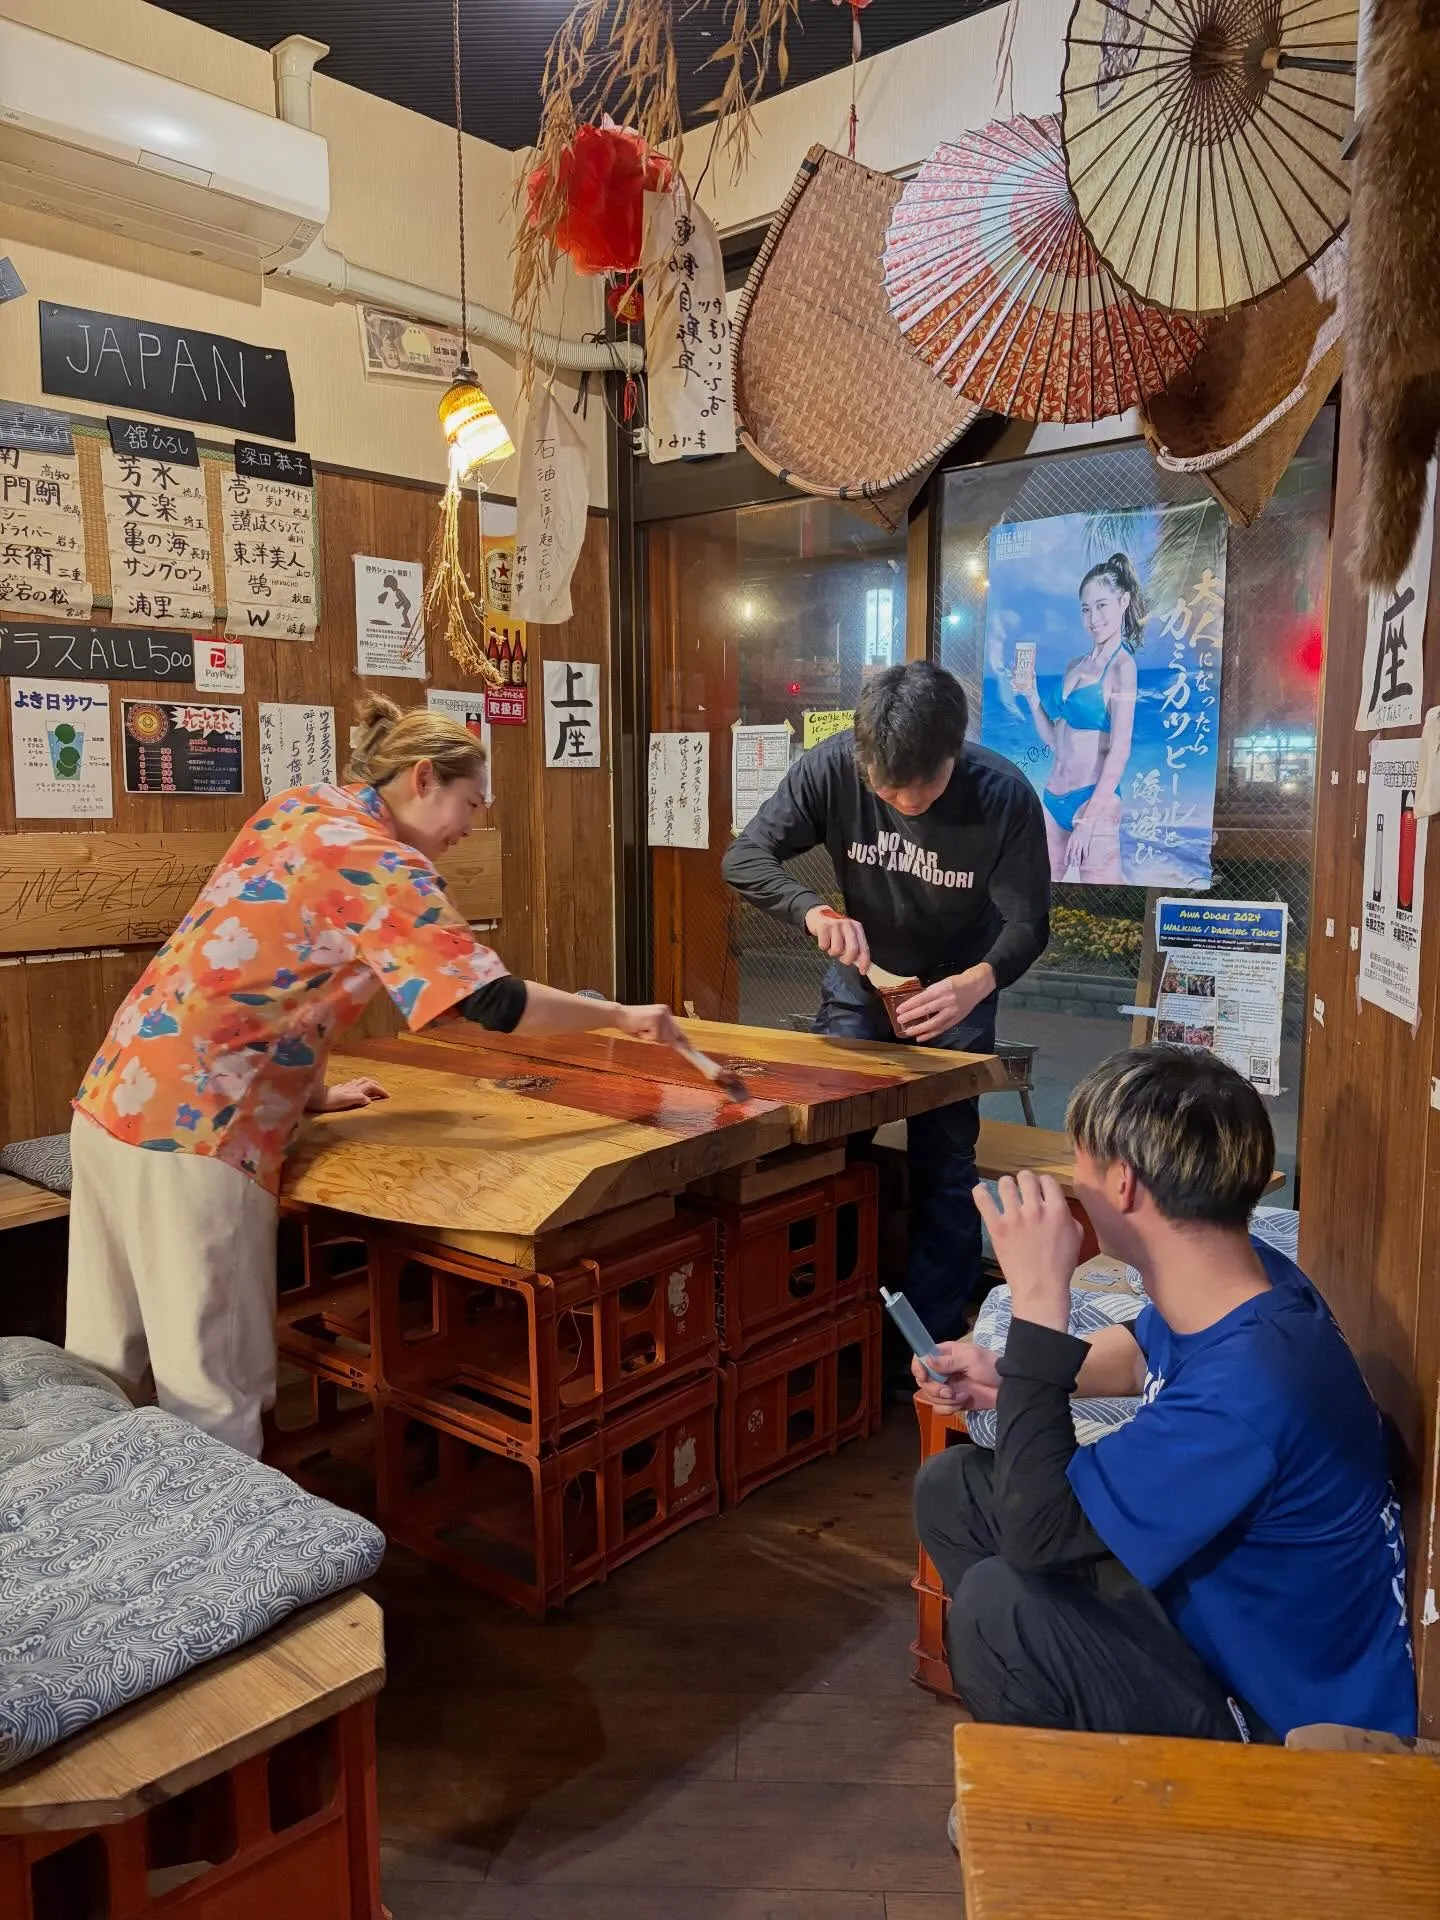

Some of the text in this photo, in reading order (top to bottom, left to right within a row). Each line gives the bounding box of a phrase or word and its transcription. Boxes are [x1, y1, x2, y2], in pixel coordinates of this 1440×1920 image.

[65, 324, 247, 409] JAPAN
[240, 447, 308, 475] 深田恭子
[40, 464, 70, 480] 高知
[118, 456, 180, 490] 芳水
[118, 492, 179, 523] 文楽
[183, 517, 207, 530] 埼玉
[56, 535, 78, 549] 岩手
[123, 522, 190, 557] 亀の海
[233, 542, 305, 571] 東洋美人
[57, 568, 82, 582] 三重
[123, 558, 202, 582] サングロウ
[296, 568, 311, 578] 山口
[191, 583, 211, 593] 山形
[128, 595, 175, 620] 浦里
[291, 592, 312, 605] 秋田
[247, 609, 271, 627] W
[1367, 586, 1415, 718] 座
[205, 669, 235, 680] PayPay
[14, 691, 108, 711] よき日サワー
[489, 701, 522, 716] 取扱店
[184, 709, 229, 720] ルーレット
[550, 663, 593, 761] 上座
[847, 842, 885, 867] JUST
[877, 830, 938, 868] NO WAR
[1179, 910, 1262, 922] AWA ODORI 2024
[1163, 923, 1202, 933] WALKING
[1211, 927, 1248, 936] DANCING
[1251, 928, 1281, 938] TOURS
